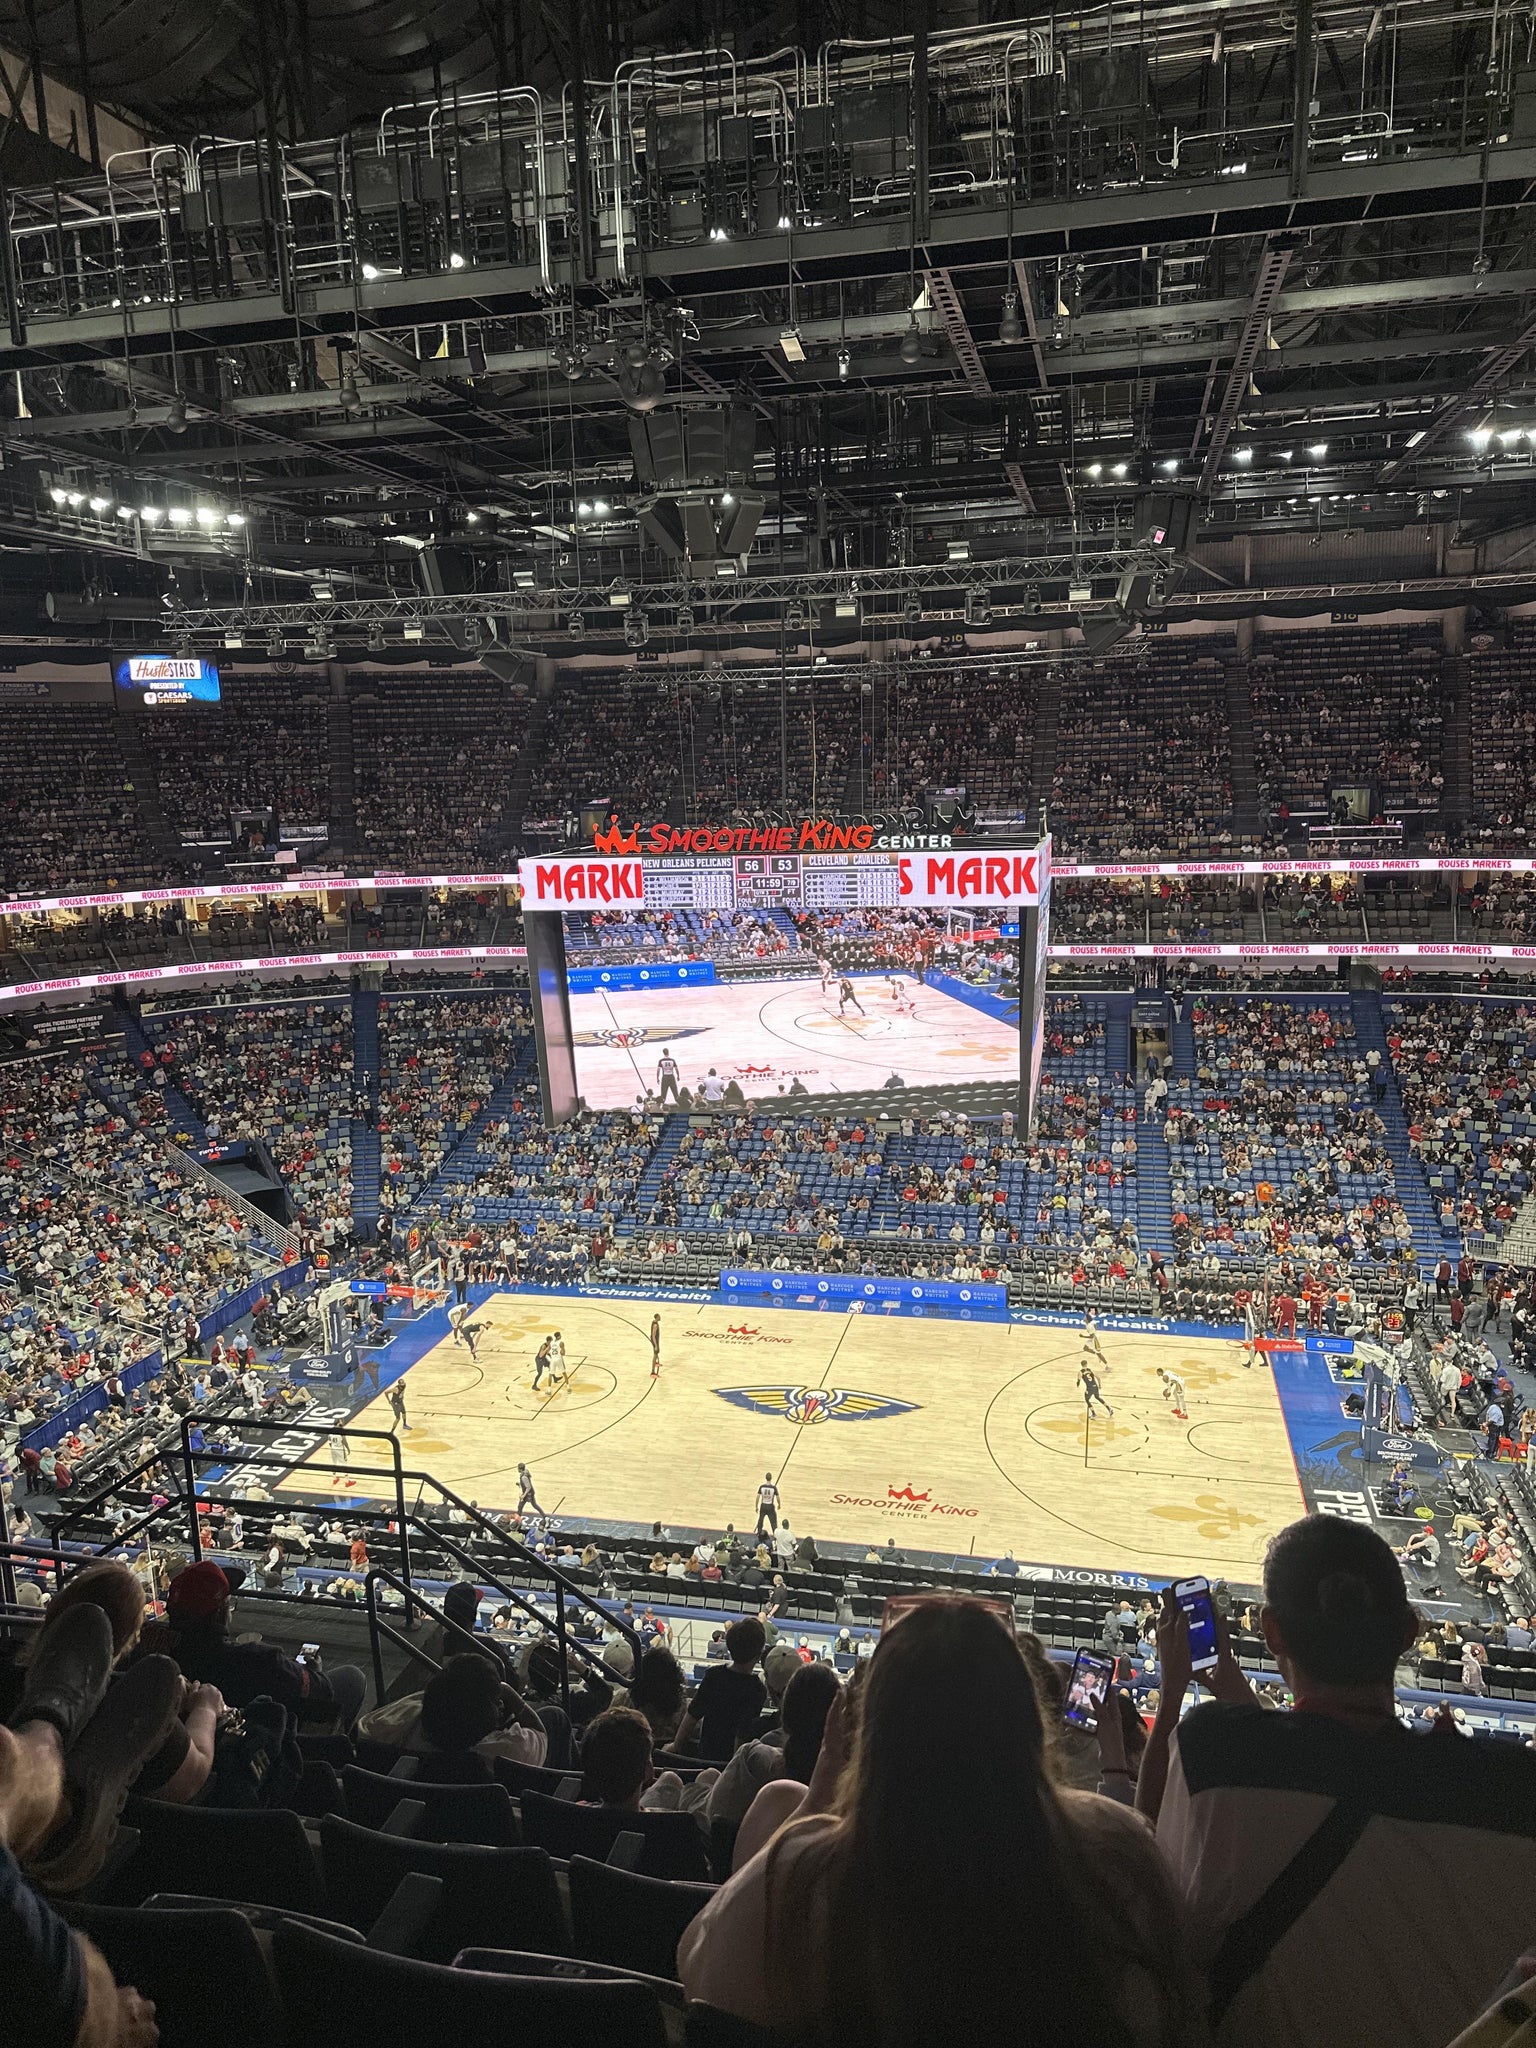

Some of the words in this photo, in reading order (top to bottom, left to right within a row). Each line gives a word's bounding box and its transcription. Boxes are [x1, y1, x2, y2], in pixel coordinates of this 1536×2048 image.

[647, 823, 795, 853] SMOOTHIE
[878, 835, 952, 850] CENTER
[643, 859, 660, 869] NEW
[662, 858, 694, 868] ORLEANS
[696, 858, 732, 867] PELICANS
[809, 855, 848, 866] CLEVELAND
[853, 854, 890, 865] CAVALIERS
[1350, 860, 1378, 869] ROUSES
[1383, 860, 1419, 869] MARKETS
[1438, 859, 1469, 869] ROUSES
[1473, 859, 1511, 869] MARKETS
[744, 860, 759, 871] 56
[778, 860, 792, 871] 53
[1050, 865, 1077, 875] ARKETS
[1096, 865, 1122, 874] ROUSES
[1126, 865, 1159, 874] MARKETS
[1177, 864, 1205, 873] ROUSES
[1209, 863, 1244, 872] MARKETS
[1263, 862, 1291, 871] ROUSES
[1295, 861, 1331, 870] MARKETS
[300, 881, 325, 889] ROUSES
[329, 879, 359, 888] MARKETS
[375, 878, 399, 886] ROUSES
[403, 877, 432, 886] MARKETS
[448, 876, 471, 884] ROUSES
[475, 875, 503, 883] MARKETS
[755, 879, 781, 888] 11:59
[221, 885, 248, 894] ROUSES
[251, 883, 283, 892] MARKETS
[142, 891, 168, 900] ROUSES
[172, 888, 204, 897] MARKETS
[59, 897, 87, 907] ROUSES
[90, 894, 123, 904] MARKETS
[6, 901, 41, 911] MARKETS
[413, 950, 437, 958] ROUSES
[442, 949, 470, 957] MARKETS
[487, 947, 510, 955] ROUSES
[1070, 946, 1098, 955] ROUSES
[1101, 946, 1135, 955] MARKETS
[1154, 945, 1181, 955] ROUSES
[1185, 945, 1221, 954] MARKETS
[1240, 945, 1268, 954] ROUSES
[1272, 945, 1309, 954] MARKETS
[1328, 945, 1357, 954] ROUSES
[1362, 945, 1399, 954] MARKETS
[1418, 944, 1449, 954] ROUSES
[1453, 945, 1492, 956] MARKETS
[1512, 947, 1536, 957] ROUS
[259, 958, 286, 967] ROUSES
[289, 955, 321, 964] MARKETS
[338, 953, 364, 961] ROUSES
[366, 951, 397, 960] MARKETS
[178, 965, 206, 975] ROUSES
[209, 961, 242, 971] MARKETS
[98, 973, 124, 983] ROUSES
[128, 969, 162, 980] MARKETS
[16, 983, 42, 994] ROUSES
[45, 979, 80, 989] MARKETS
[696, 1072, 775, 1082] SOOTHIE
[586, 1287, 653, 1298] Ochsner
[655, 1291, 712, 1301] Health
[1103, 1319, 1170, 1331] Health
[682, 1331, 755, 1341] SMOOTHIE
[830, 1494, 927, 1512] SMOOTHIE
[881, 1510, 928, 1520] CENTER
[1054, 1569, 1150, 1588] MORRIS
